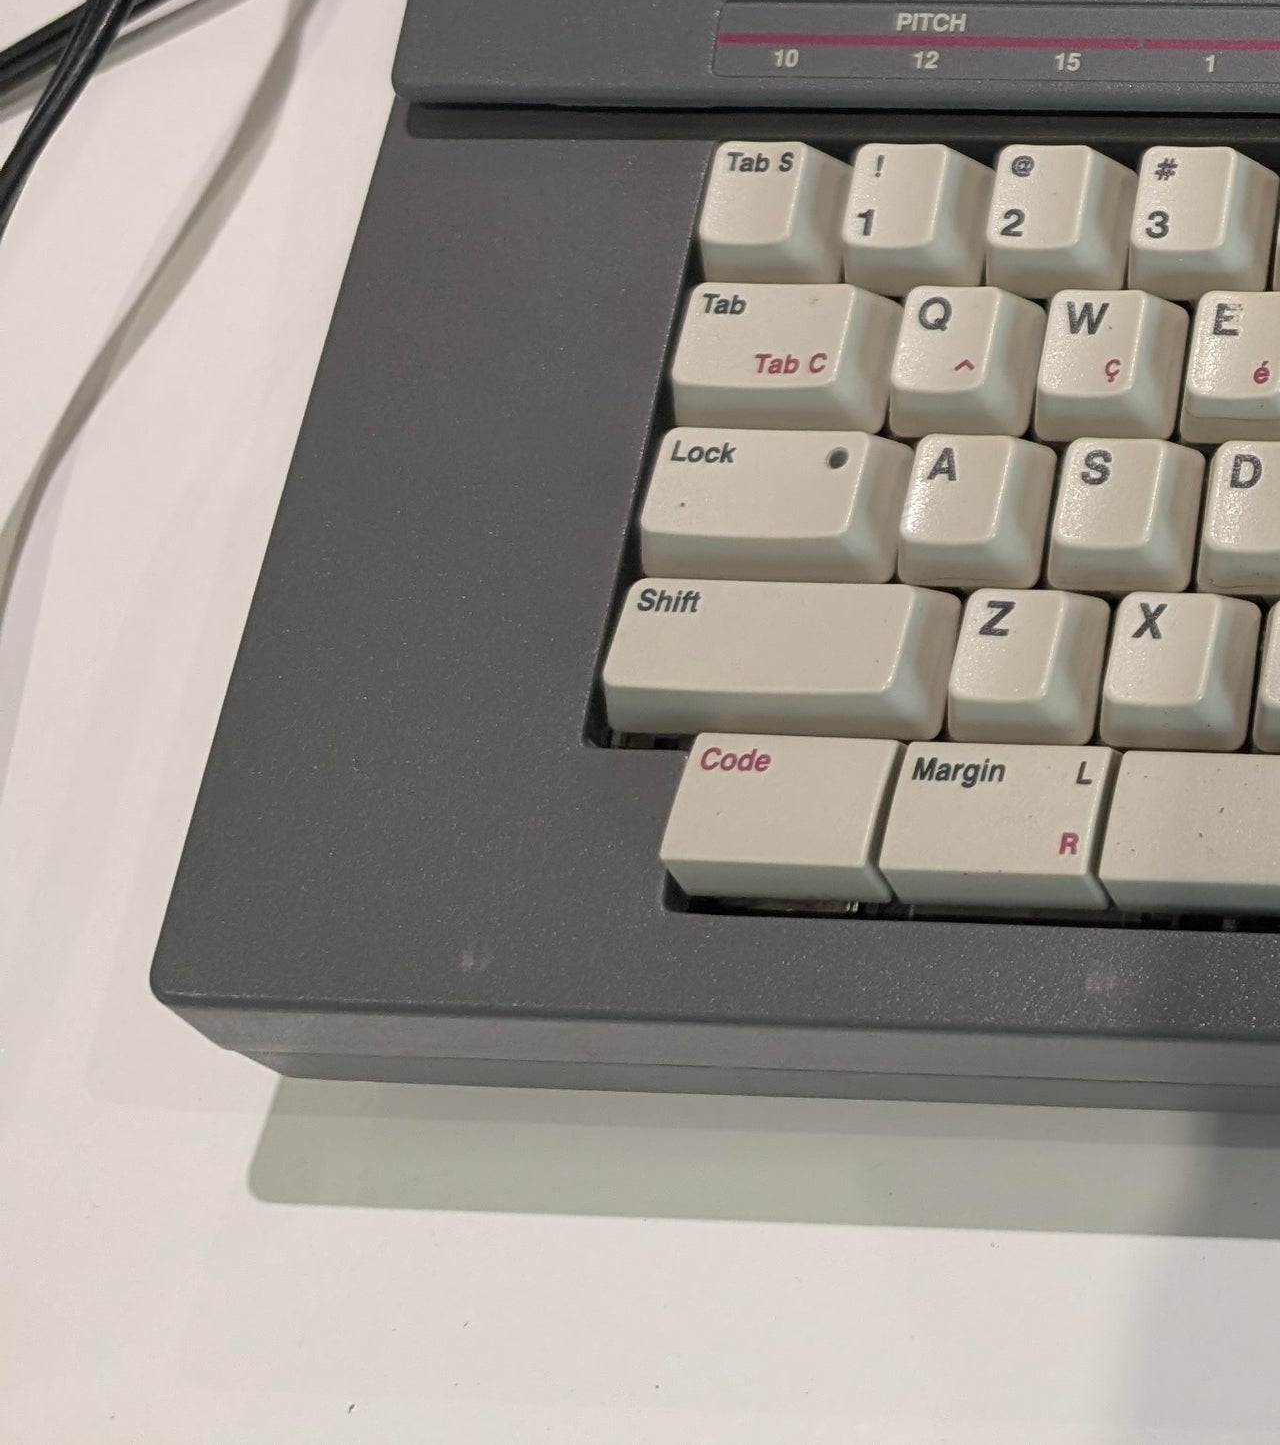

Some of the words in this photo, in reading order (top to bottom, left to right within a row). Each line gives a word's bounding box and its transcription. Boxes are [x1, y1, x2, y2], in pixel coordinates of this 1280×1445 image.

[896, 13, 966, 31] PITCH
[774, 49, 798, 67] 10
[914, 51, 939, 69] 12
[1055, 53, 1080, 71] 15
[1206, 55, 1214, 72] 1
[728, 152, 769, 172] Tab
[779, 152, 793, 172] S
[875, 155, 884, 177] !
[1011, 156, 1034, 177] @
[1155, 159, 1177, 180] #
[858, 210, 873, 236] 1
[1000, 209, 1024, 237] 2
[1146, 211, 1168, 238] 3
[704, 294, 746, 315] Tab
[918, 297, 951, 331] Q
[1068, 303, 1109, 335] W
[1212, 304, 1242, 336] E
[755, 354, 800, 375] Tab
[808, 353, 827, 375] C
[1104, 358, 1121, 382] ç
[1253, 362, 1270, 384] é
[671, 441, 735, 463] Lock
[927, 448, 956, 481] A
[1081, 451, 1111, 485] S
[1230, 455, 1261, 488] D
[637, 589, 700, 612] Shift
[979, 601, 1014, 636] Z
[1133, 603, 1166, 639] X
[700, 748, 771, 772] Code
[912, 758, 1005, 788] Margin
[1076, 761, 1091, 785] L
[1059, 833, 1079, 854] R
